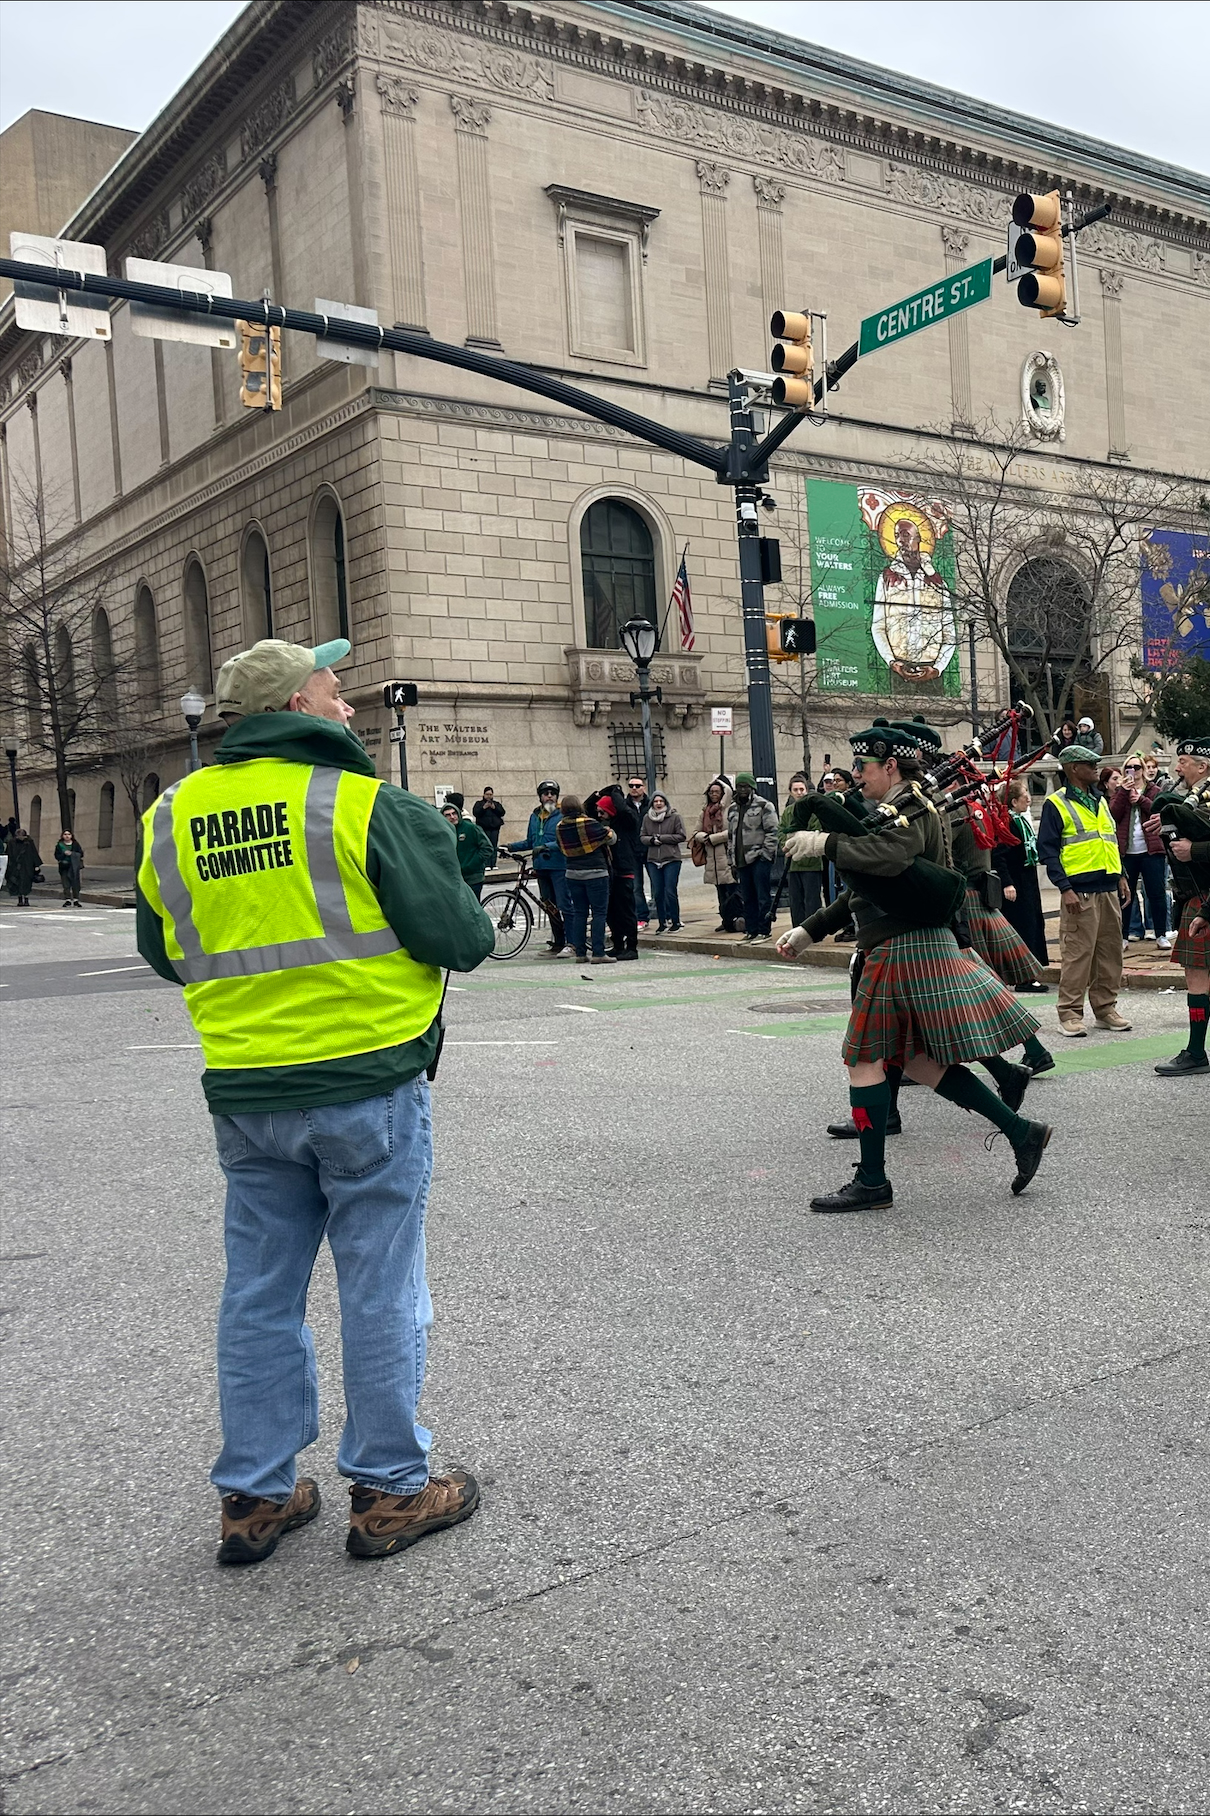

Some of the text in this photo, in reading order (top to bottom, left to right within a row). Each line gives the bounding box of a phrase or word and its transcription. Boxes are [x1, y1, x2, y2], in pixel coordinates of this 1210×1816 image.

[876, 276, 975, 342] CENTRE ST.
[815, 544, 826, 552] TO
[815, 552, 839, 561] YOUR
[816, 560, 853, 570] WALTERS
[817, 584, 846, 593] ALWAYS
[818, 592, 837, 600] FREE
[818, 600, 859, 610] ADMISSION
[827, 678, 859, 687] MUSEUM
[418, 724, 488, 733] THE WALTERS
[420, 735, 490, 743] ART MUSEUM
[190, 801, 290, 852] PARADE
[196, 839, 294, 882] COMMITTEE
